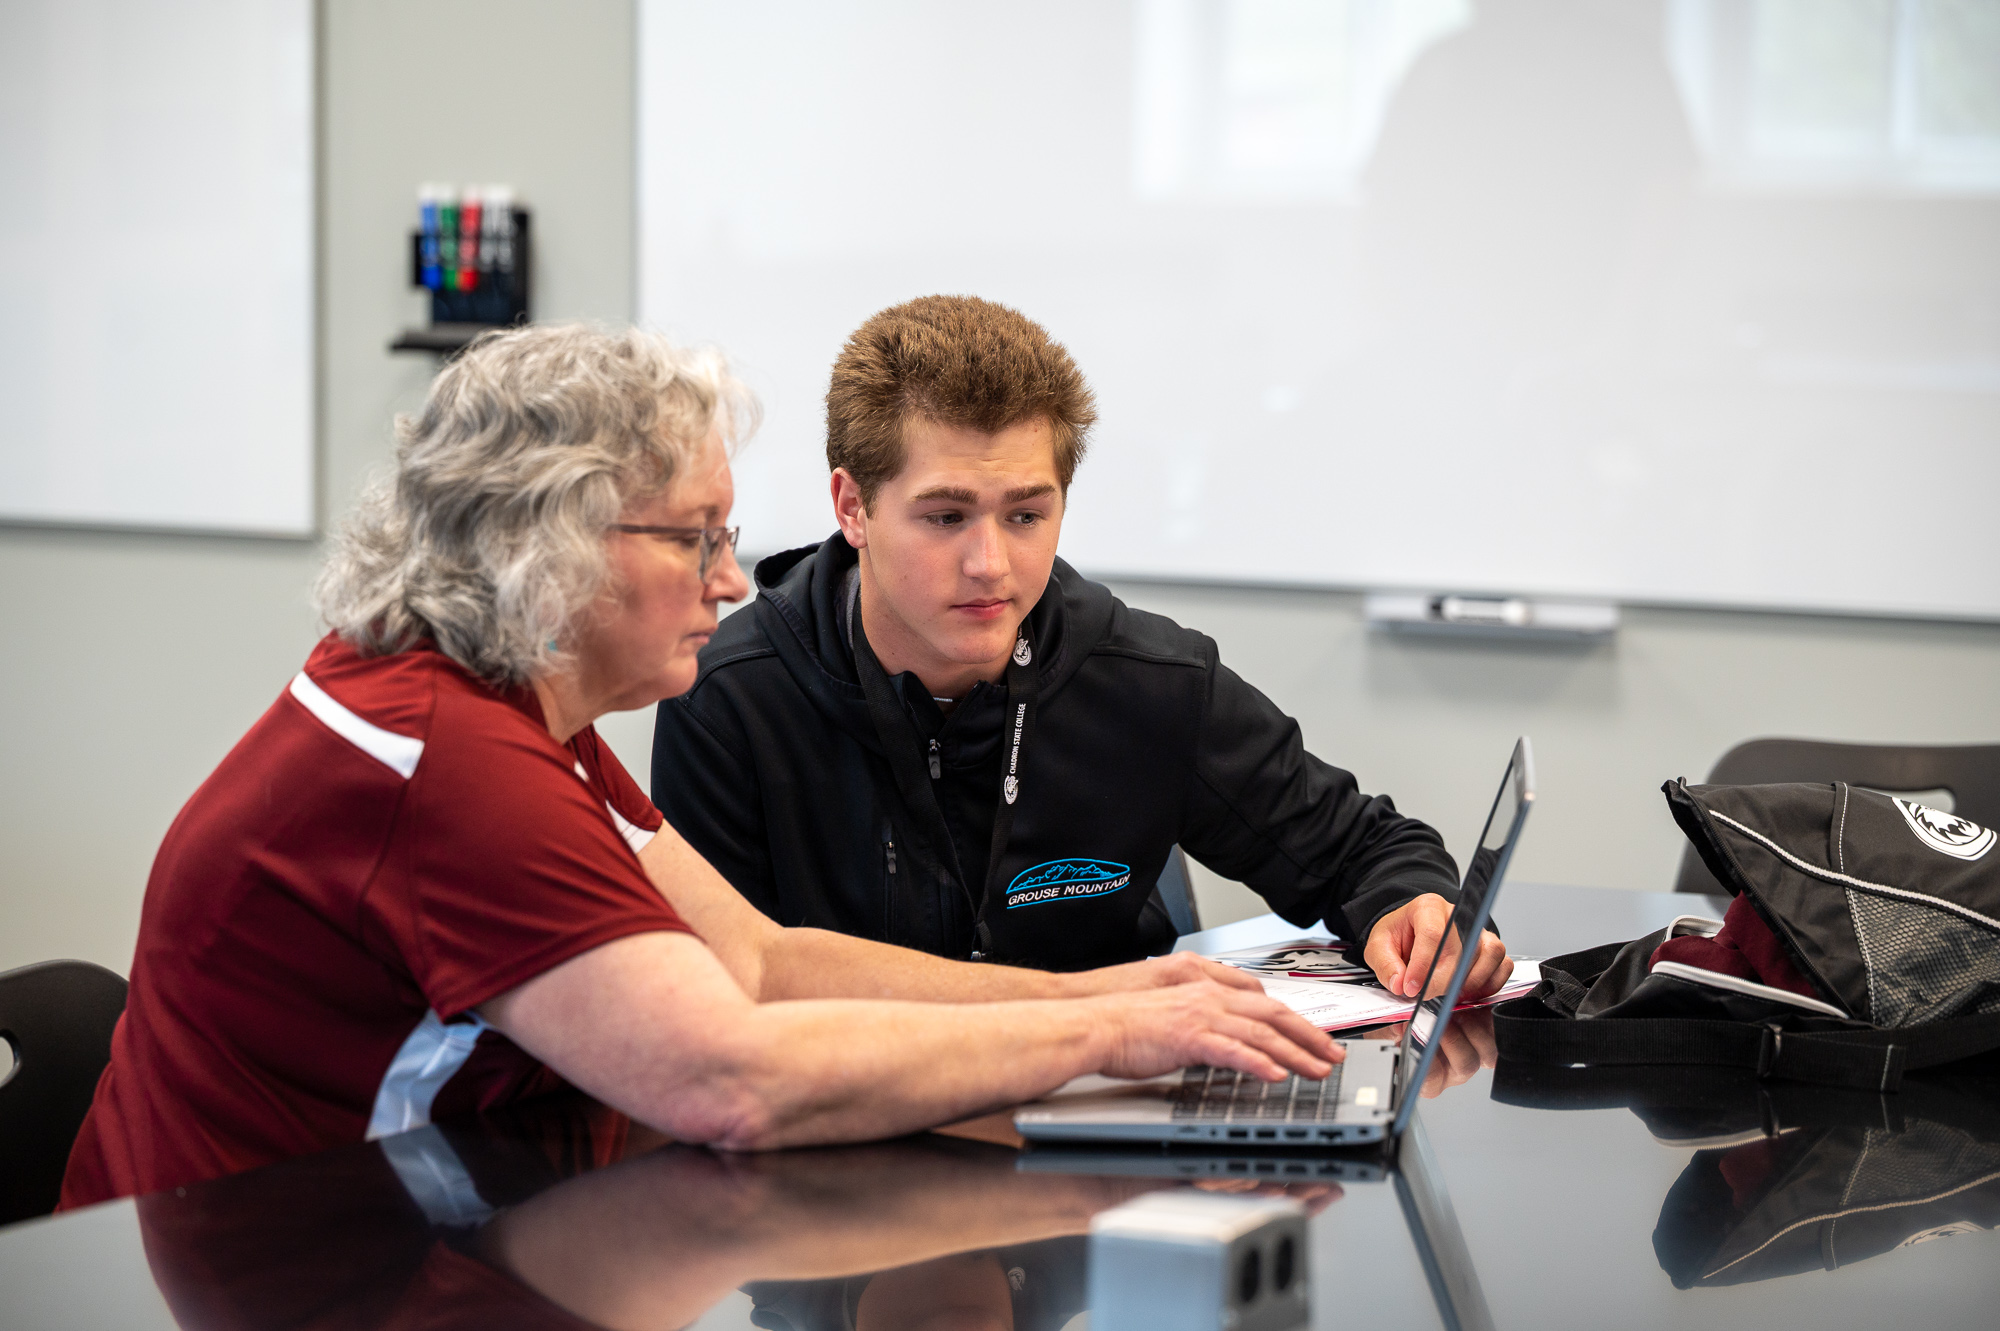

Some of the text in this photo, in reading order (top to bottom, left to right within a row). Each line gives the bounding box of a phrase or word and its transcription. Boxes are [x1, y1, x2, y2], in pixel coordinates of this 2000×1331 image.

[1009, 703, 1026, 774] CHADRON STATE COLLEGE
[1008, 873, 1131, 905] GROUSE MOUNTAIN
